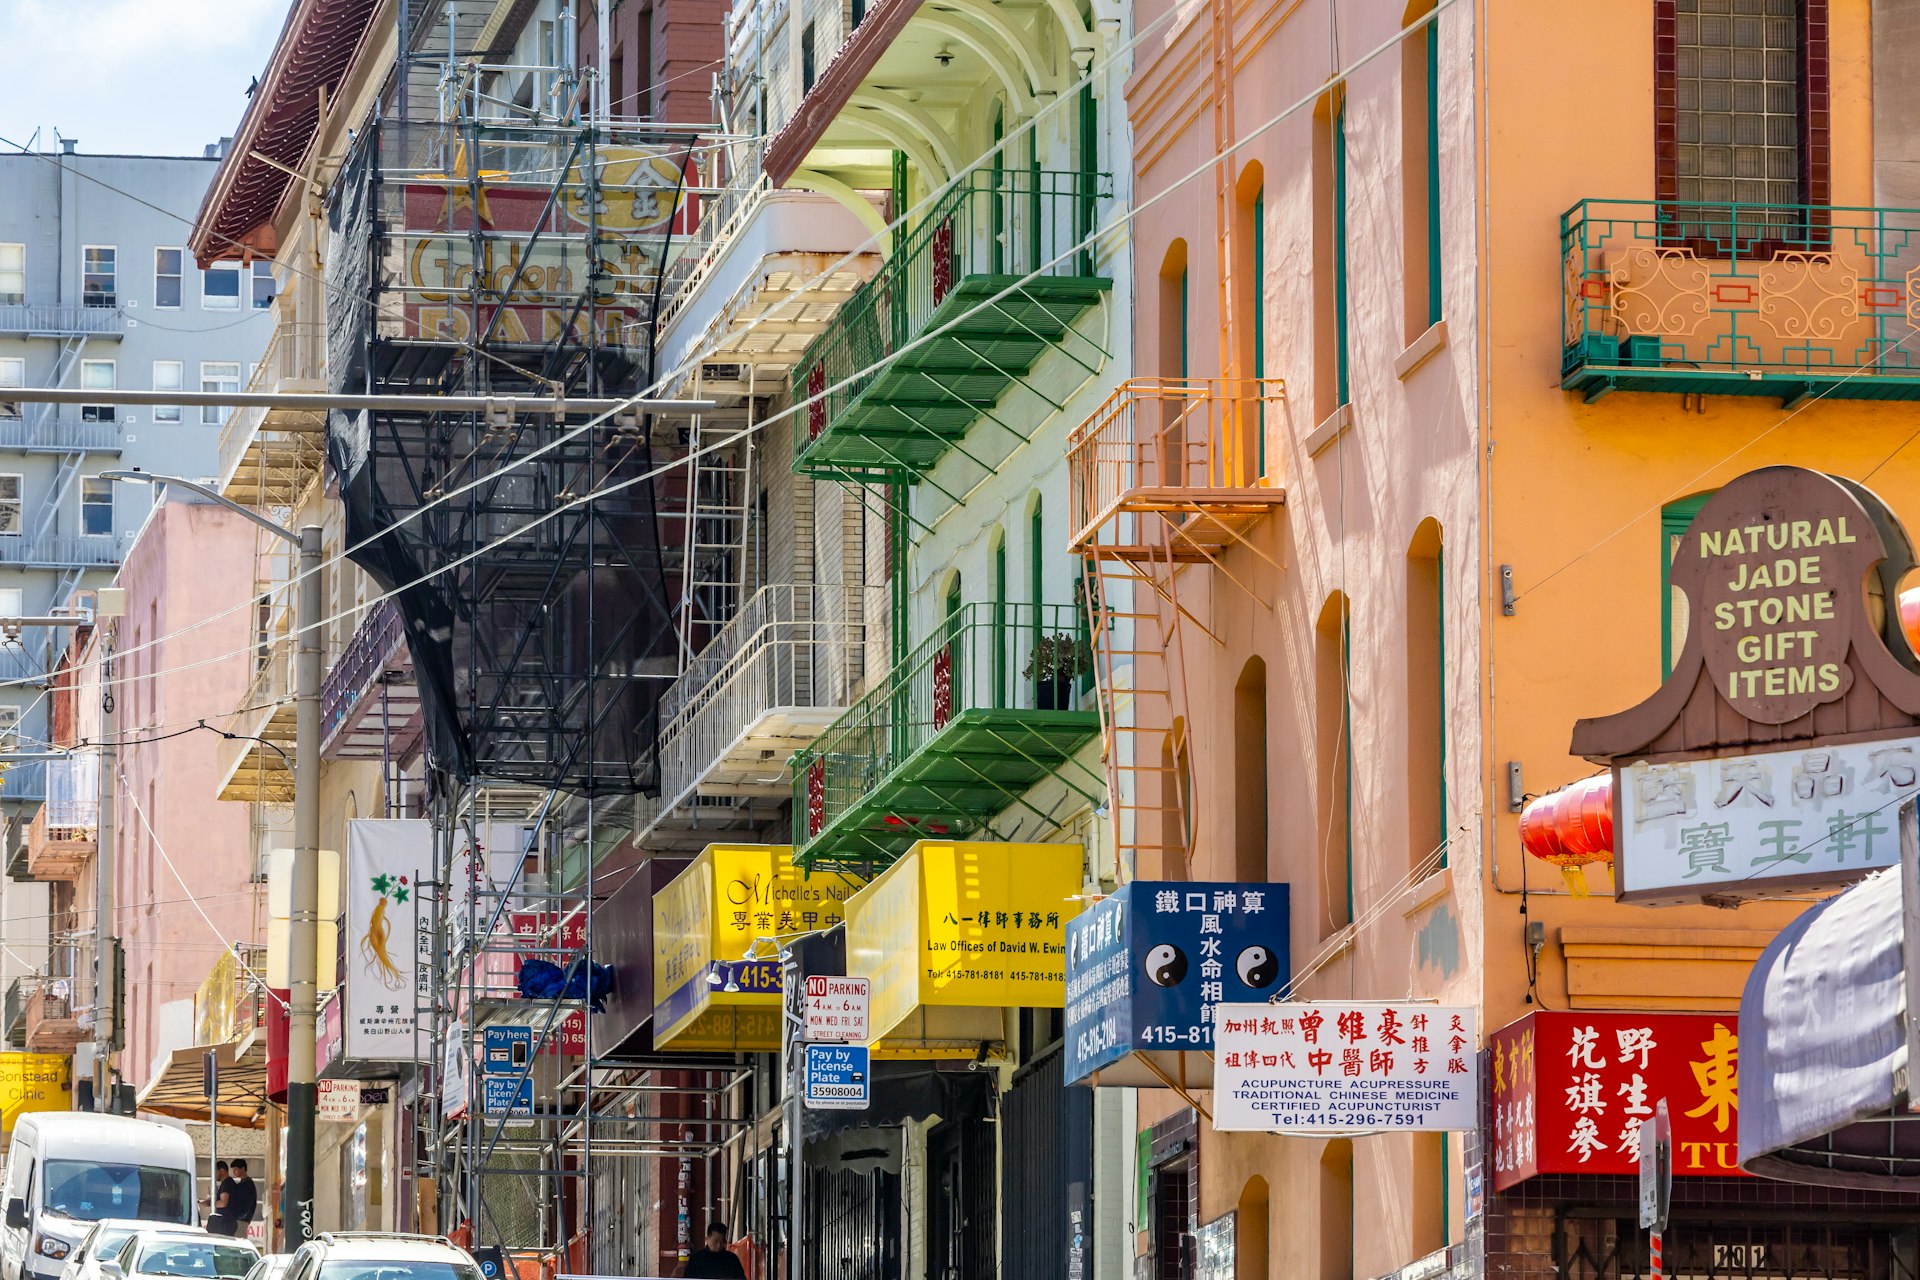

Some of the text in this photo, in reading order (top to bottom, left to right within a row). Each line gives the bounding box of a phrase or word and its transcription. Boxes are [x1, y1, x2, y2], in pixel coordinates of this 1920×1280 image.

[411, 230, 572, 302] Golden
[1700, 516, 1857, 559] NATURAL
[1728, 556, 1821, 592] JADE
[1714, 592, 1835, 630] STONE
[1737, 631, 1819, 663] GIFT
[1729, 663, 1840, 699] ITEMS
[1678, 808, 1889, 879] 寶玉軒
[727, 873, 850, 905] Michelle's Nail
[1155, 890, 1265, 914] 鐵口神算
[943, 911, 1059, 930] 八一律師事務所
[927, 940, 947, 951] Law
[950, 940, 984, 952] Offices
[987, 941, 996, 952] of
[999, 941, 1026, 953] David
[1029, 942, 1040, 954] W.
[927, 969, 943, 979] Tel:
[946, 970, 1004, 980] 415-781-8181
[1199, 914, 1223, 1024] 風水命相館
[808, 978, 866, 996] NO PARKING
[813, 999, 821, 1010] 4
[843, 1000, 849, 1011] 6
[487, 1030, 529, 1041] Pay here
[813, 1030, 833, 1038] STREET
[1141, 1025, 1215, 1044] 415-81
[1224, 1017, 1295, 1036] 加州執照
[1298, 1008, 1406, 1047] 曾維豪
[1077, 1016, 1117, 1063] 415-816-2184
[811, 1049, 850, 1063] Pay by
[1224, 1050, 1296, 1069] 祖傳四代
[1308, 1048, 1394, 1077] 中醫師
[811, 1061, 853, 1072] License
[320, 1081, 358, 1092] NO PARKING
[488, 1080, 505, 1091] Pay
[811, 1071, 840, 1083] Plate
[1241, 1080, 1450, 1089] ACUPUNCTURE ACUPRESSURE
[1892, 1066, 1909, 1096] JAD
[9, 1088, 45, 1100] Clinic
[323, 1094, 328, 1102] 4
[812, 1086, 862, 1097] 35908004
[1233, 1091, 1459, 1100] TRADITIONAL CHINESE MEDICINE
[1565, 1025, 1609, 1164] 花旗參
[1251, 1102, 1441, 1111] CERTIFIED ACUPUNCTURIST
[1272, 1113, 1424, 1125] Tel:415-296-7591
[1717, 1246, 1763, 1268] 101
